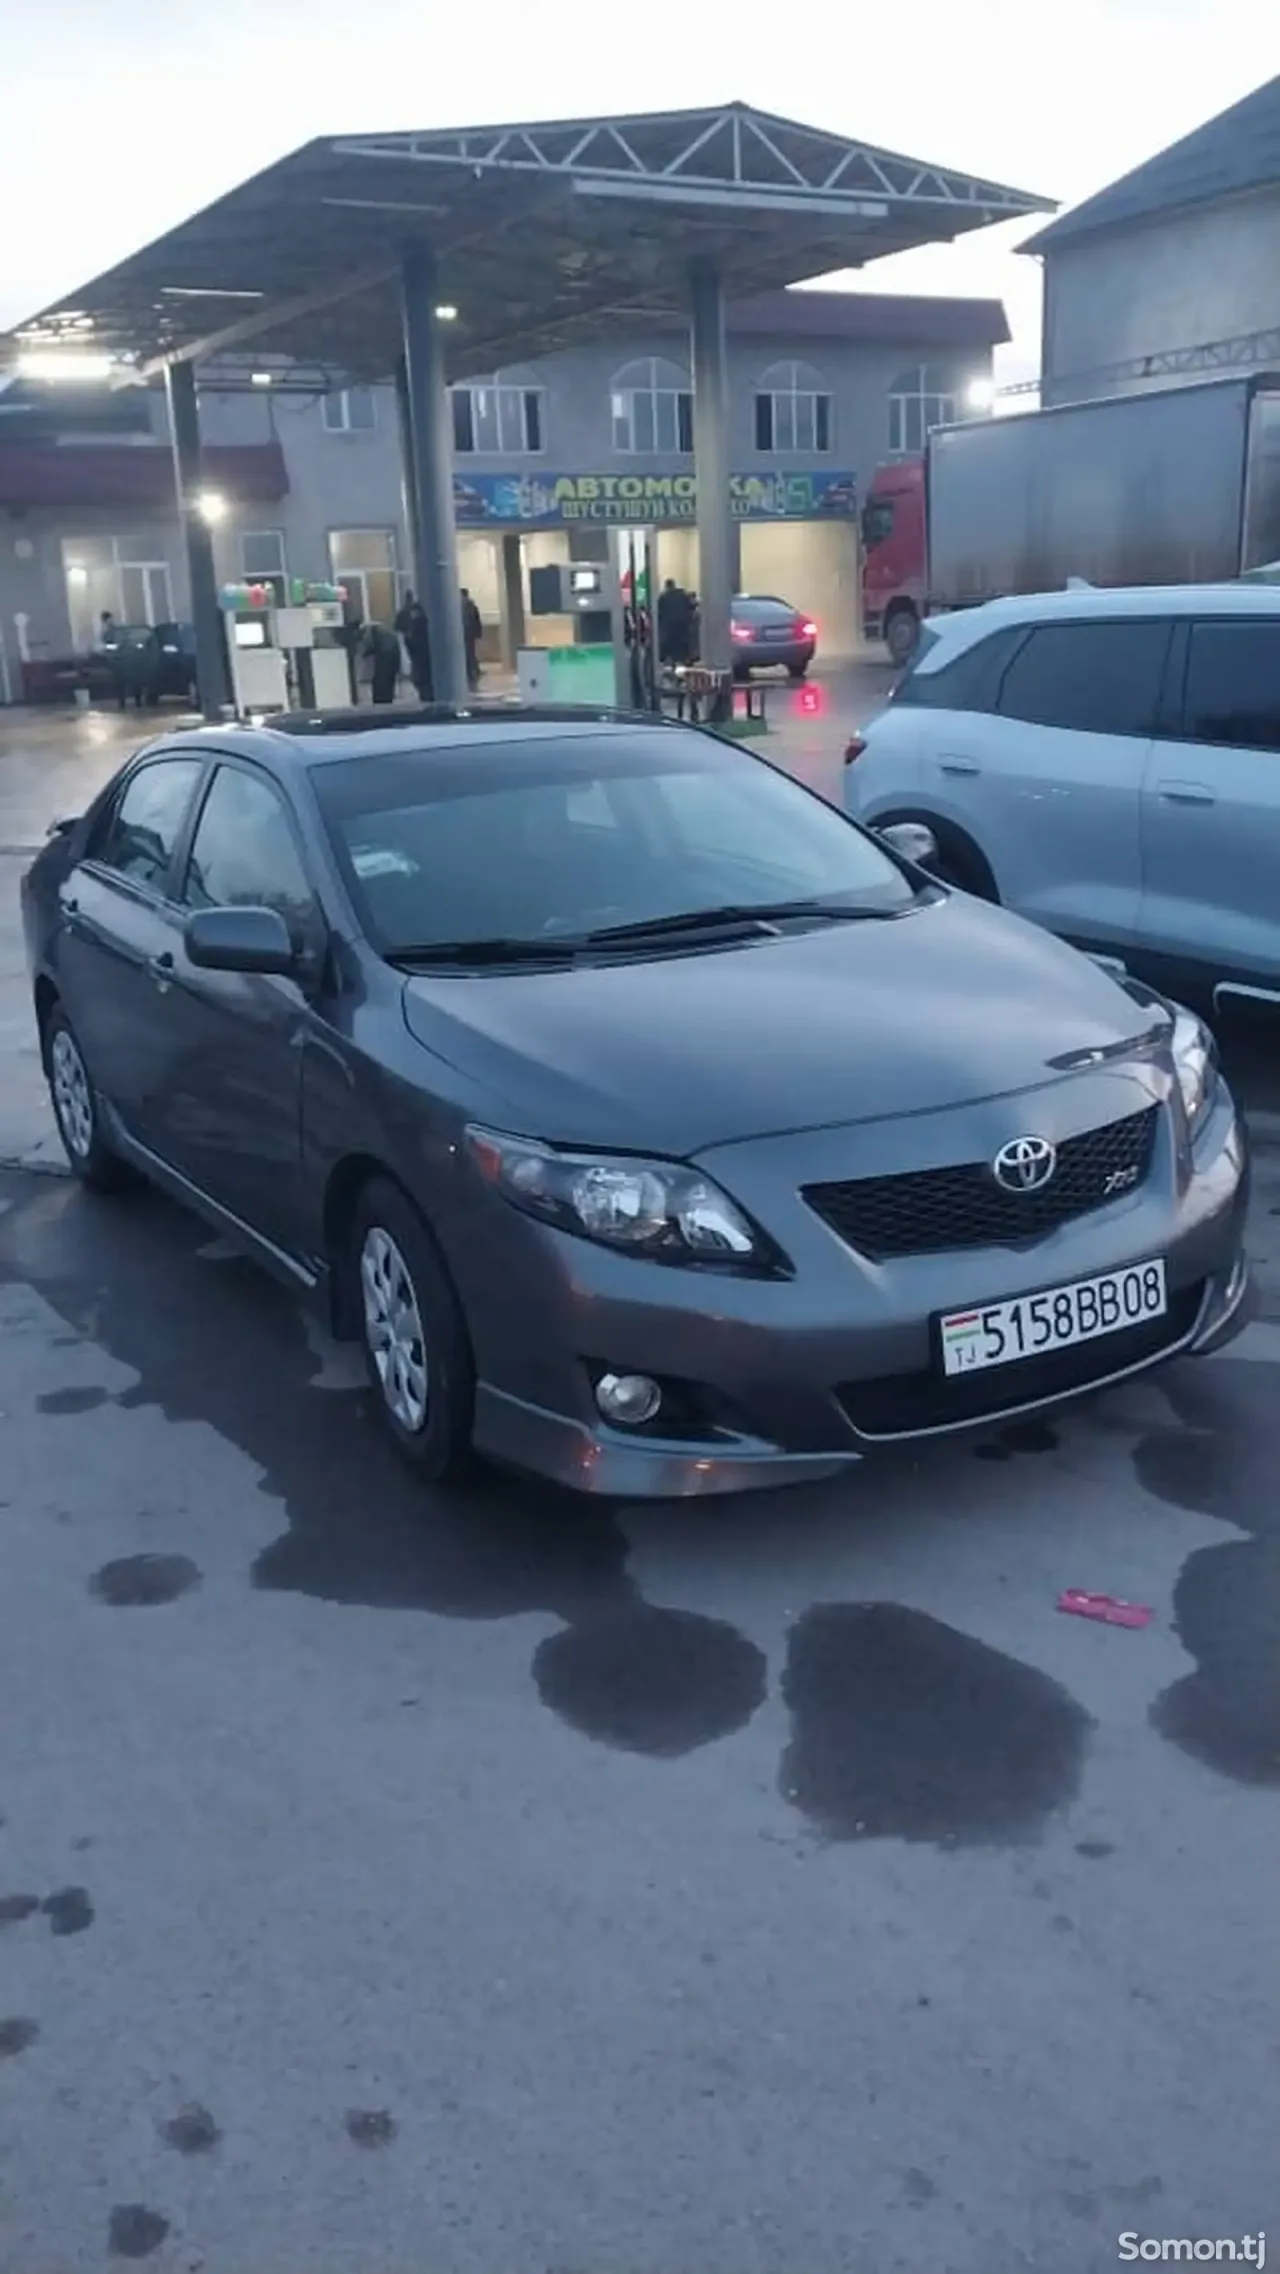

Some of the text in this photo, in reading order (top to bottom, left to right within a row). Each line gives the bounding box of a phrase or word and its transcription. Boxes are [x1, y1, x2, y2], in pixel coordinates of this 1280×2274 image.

[554, 476, 765, 499] АВТОМОКА
[955, 1266, 1161, 1368] TJ 5158BB08
